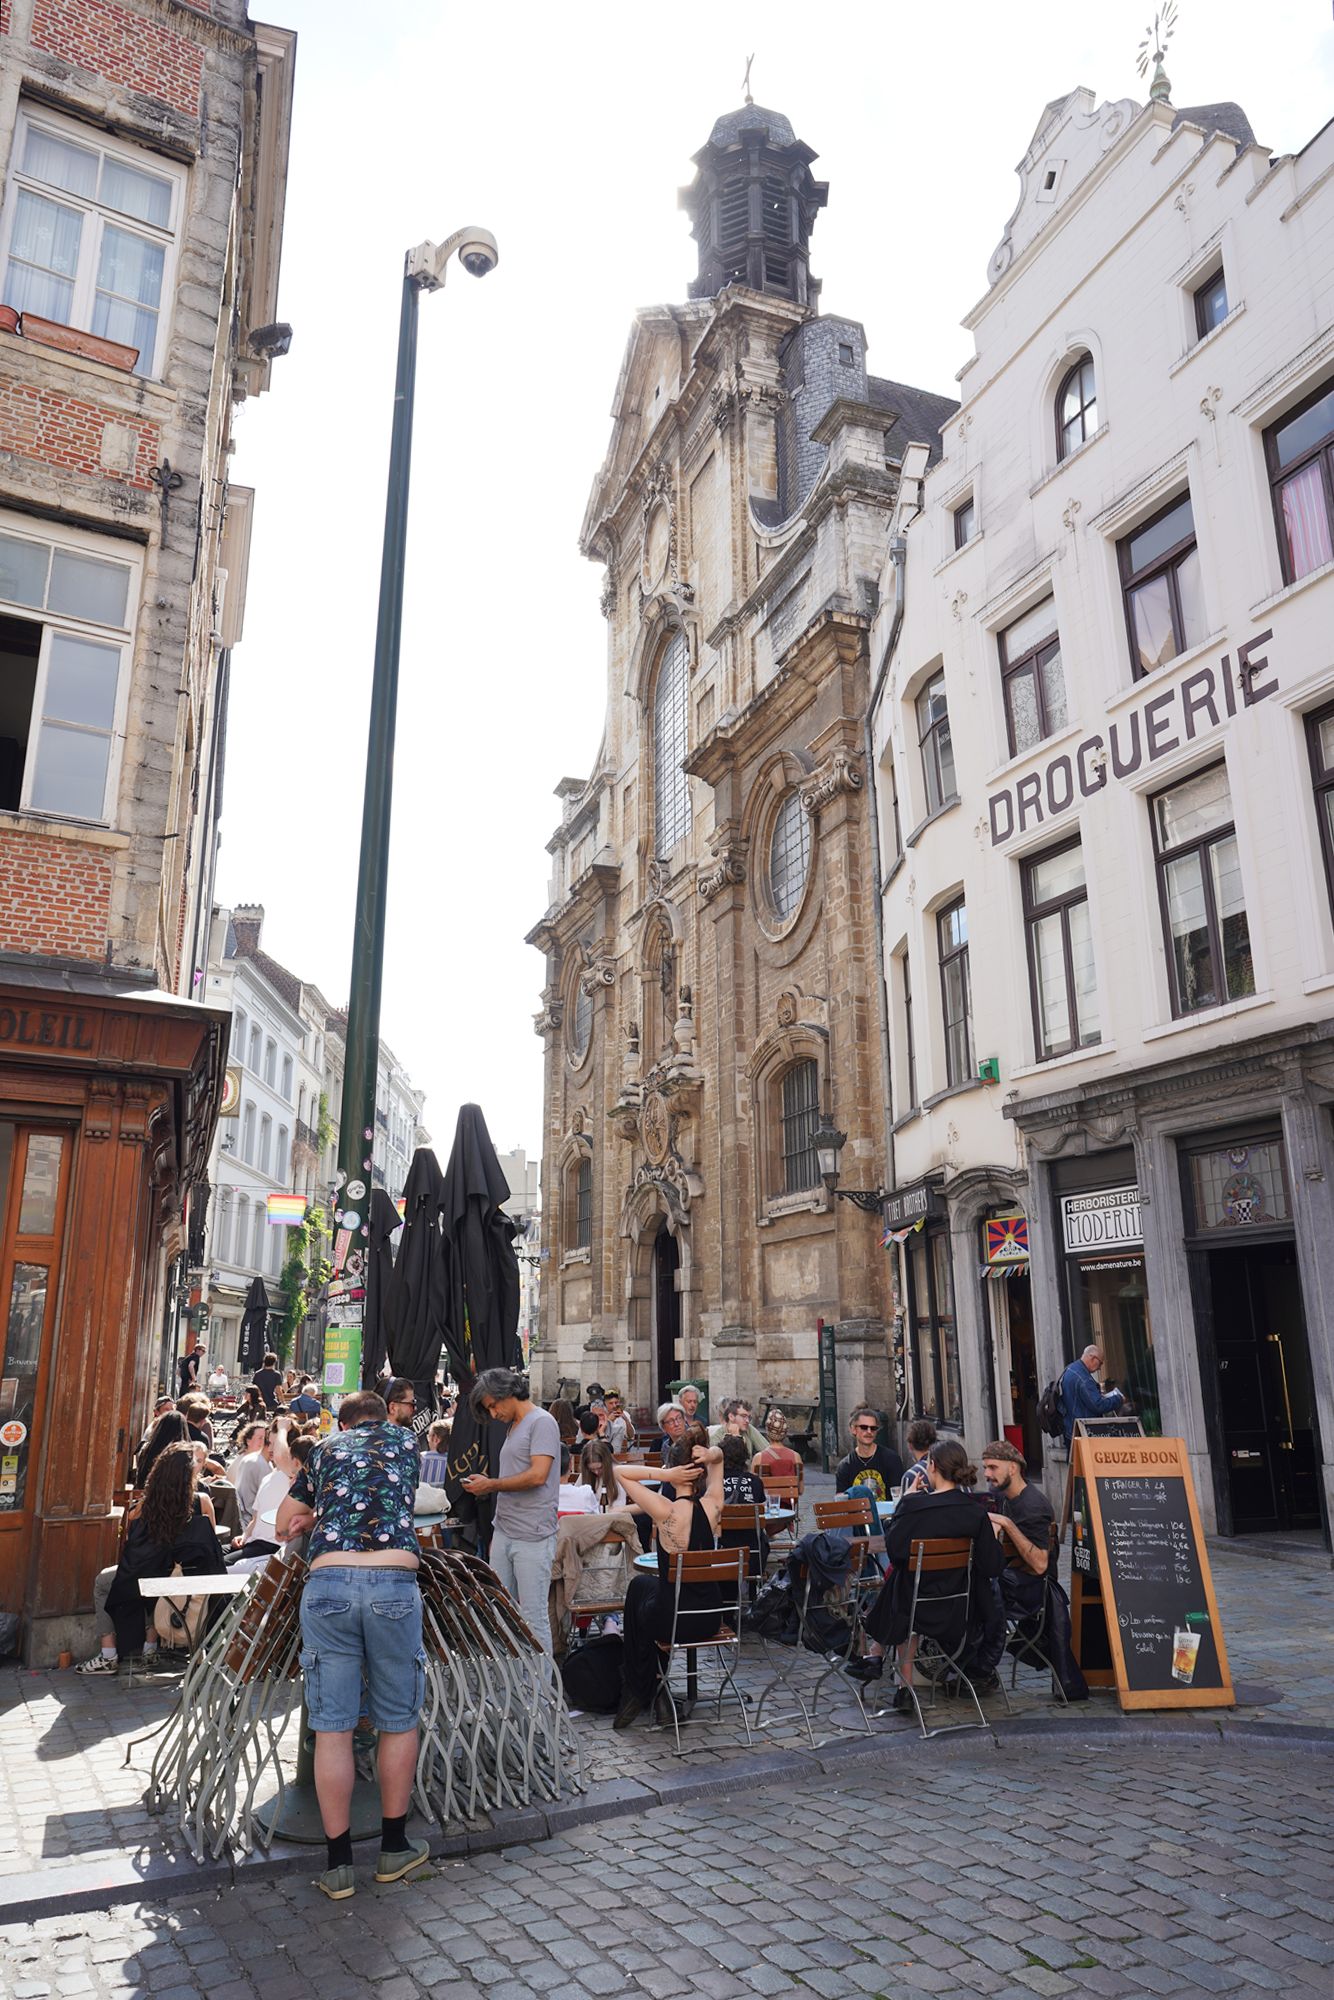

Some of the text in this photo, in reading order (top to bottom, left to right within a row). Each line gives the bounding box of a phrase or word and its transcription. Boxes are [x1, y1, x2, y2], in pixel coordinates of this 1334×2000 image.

[988, 628, 1280, 847] DROGUERIE
[887, 1188, 928, 1222] TIBET BROTHERS
[1080, 1259, 1142, 1271] www.damenature.be
[1094, 1451, 1179, 1464] GEUZE BOON
